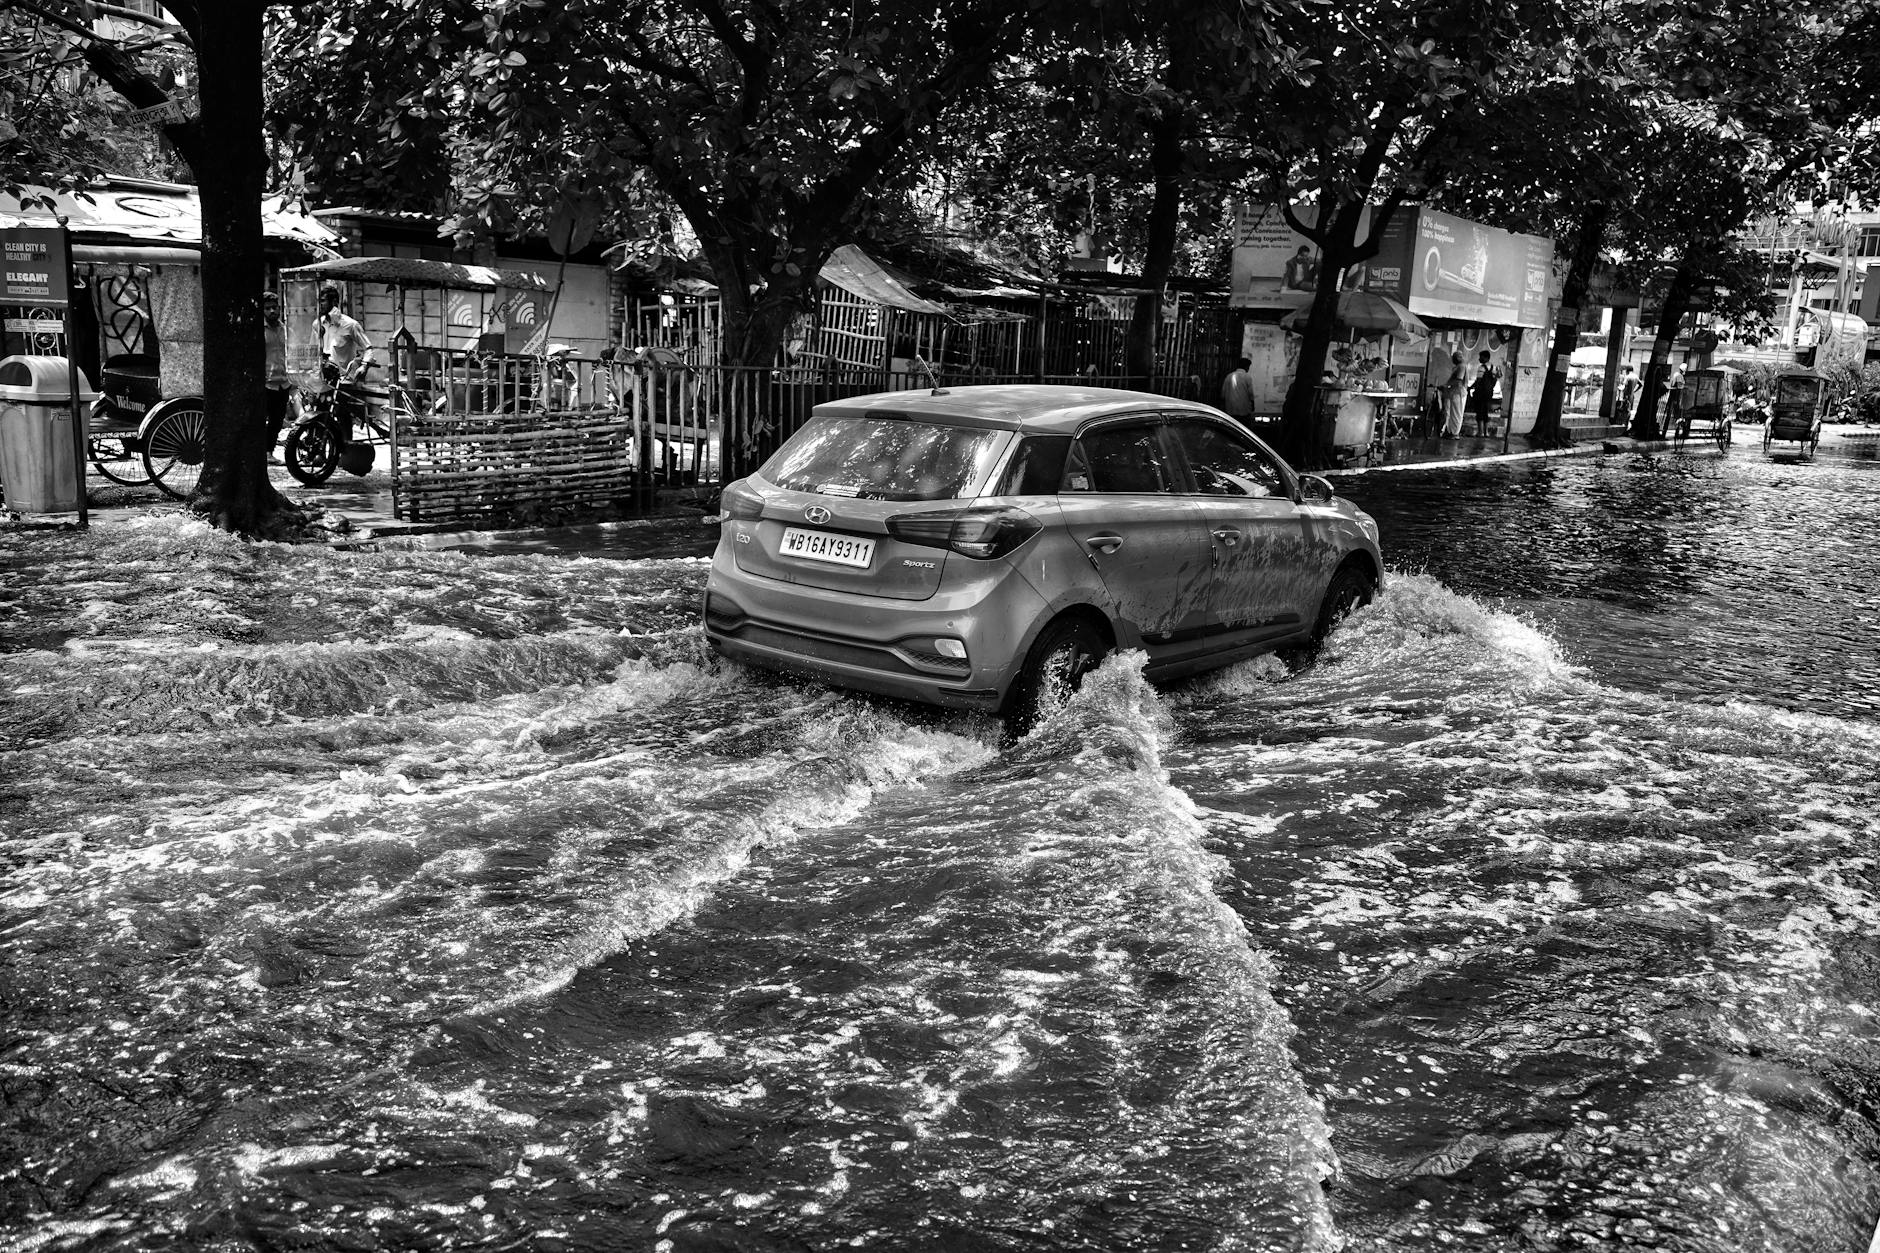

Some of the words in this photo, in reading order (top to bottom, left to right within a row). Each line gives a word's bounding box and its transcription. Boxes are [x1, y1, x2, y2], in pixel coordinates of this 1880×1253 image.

[1422, 215, 1433, 229] 0%
[5, 242, 25, 252] CLEAN
[25, 243, 39, 252] CITY
[40, 243, 47, 252] IS
[5, 252, 32, 261] HEALTHY
[6, 271, 49, 283] ELEGANT
[116, 394, 146, 413] Welcome
[788, 533, 870, 562] WB16AY9311
[902, 559, 936, 569] Sportz
